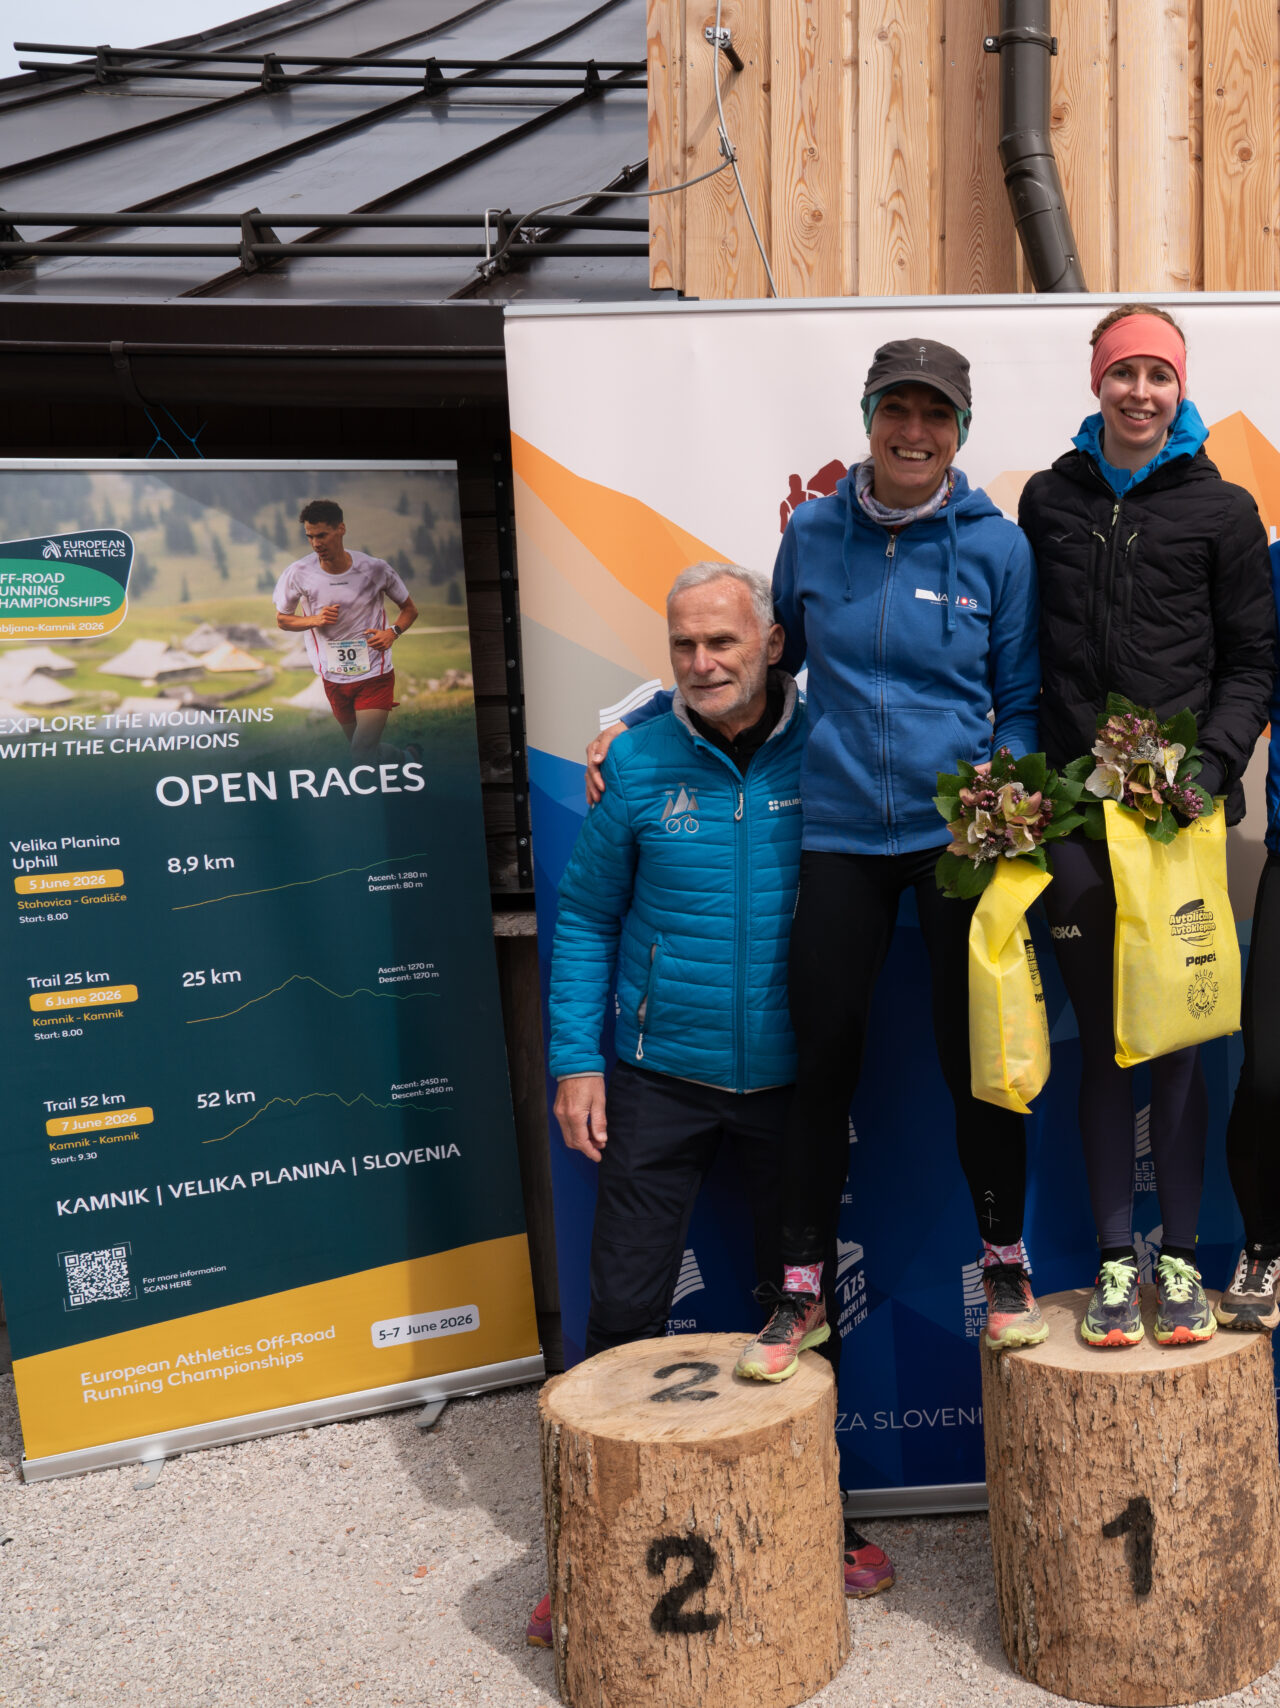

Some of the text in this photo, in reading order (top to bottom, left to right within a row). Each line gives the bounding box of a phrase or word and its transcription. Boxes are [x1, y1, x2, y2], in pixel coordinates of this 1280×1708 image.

[63, 540, 125, 549] EUROPEAN
[64, 549, 126, 558] ATHLETICS
[0, 573, 65, 584] FF-ROAD
[0, 585, 59, 596] UNNING
[0, 596, 111, 608] HAMPIONSHIPS
[0, 622, 104, 635] bljana-Kamnik 2026
[337, 649, 357, 661] 30
[0, 707, 274, 734] EXPLORE THE MOUNTAINS
[0, 733, 240, 759] WITH THE CHAMPIONS
[156, 762, 426, 807] OPEN RACES
[9, 835, 120, 853] Velika Planina
[12, 855, 58, 872] Uphill
[167, 854, 235, 875] 8,9 km
[29, 875, 106, 890] 5 June 2026
[368, 873, 396, 882] Ascent:
[368, 883, 402, 892] Descent:
[403, 881, 414, 889] 80
[17, 898, 72, 910] Stahovica
[81, 893, 127, 905] Gradišče
[19, 912, 69, 923] Start: 8.00
[378, 965, 407, 974] Ascent:
[407, 962, 425, 971] 1270
[27, 971, 110, 988] Trail 25 km
[182, 968, 242, 987] 25 km
[378, 973, 411, 983] Descent:
[413, 971, 430, 980] 1270
[45, 990, 122, 1007] 6 June 2026
[32, 1015, 75, 1027] Kamnik
[83, 1009, 125, 1022] Kamnik
[34, 1028, 84, 1041] Start: 8.00
[390, 1081, 419, 1091] Ascent:
[420, 1077, 439, 1087] 2450
[197, 1089, 256, 1109] 52 km
[391, 1090, 425, 1100] Descent:
[425, 1086, 445, 1095] 2450
[43, 1093, 126, 1112] Trail 52 km
[61, 1113, 137, 1132] 7 June 2026
[49, 1139, 91, 1151] Kamnik
[99, 1131, 140, 1145] Kamnik
[51, 1152, 98, 1165] Start: 9.30
[56, 1187, 150, 1217] KAMNIK
[168, 1174, 247, 1200] VELIKA
[250, 1159, 346, 1188] PLANINA
[363, 1143, 462, 1171] SLOVENIA
[142, 1264, 227, 1285] For more information
[143, 1280, 192, 1294] SCAN HERE
[843, 1270, 865, 1304] AZS
[859, 1292, 867, 1306] IN
[406, 1320, 437, 1336] June
[440, 1313, 473, 1330] 2026
[665, 1319, 697, 1330] TSKA
[839, 1307, 868, 1339] RAIL TEKI
[81, 1326, 336, 1387] European Athletics Off-Road
[83, 1351, 304, 1404] Running Championships
[649, 1361, 720, 1404] 2
[874, 1406, 983, 1430] SLOVENI
[1102, 1496, 1157, 1596] 1
[646, 1533, 722, 1634] 2
